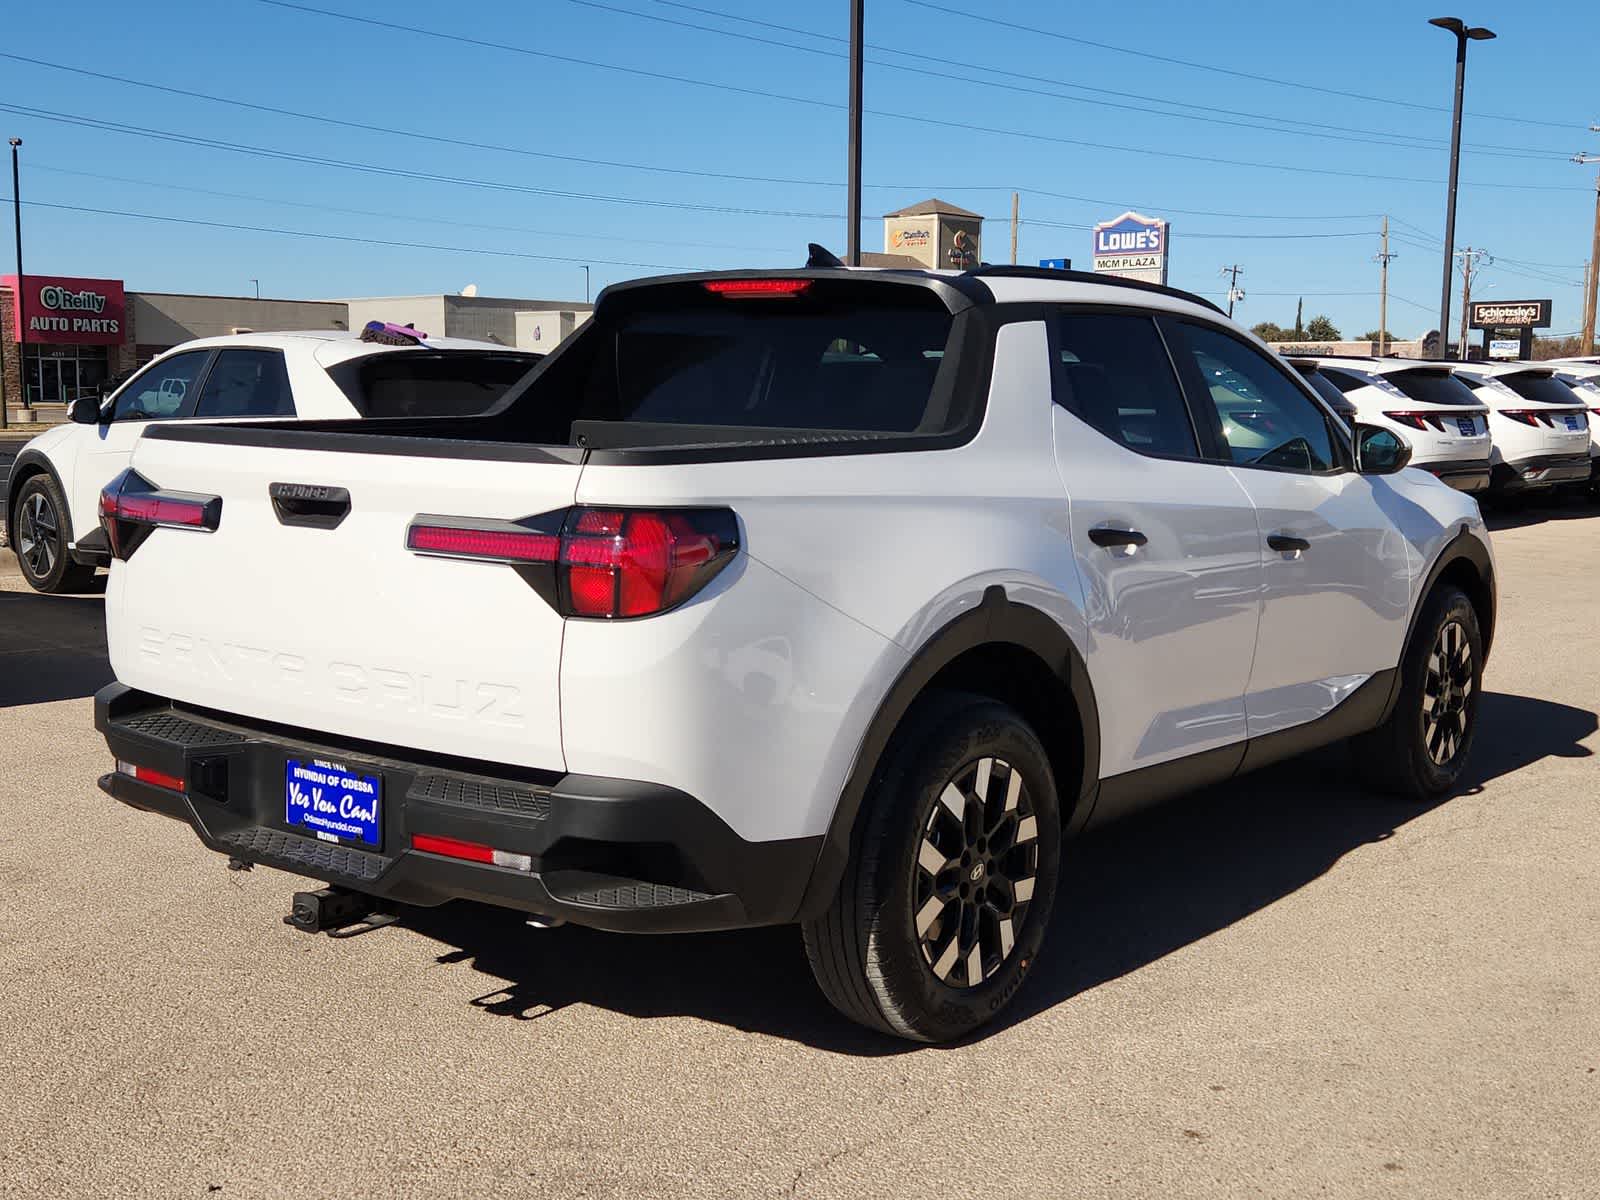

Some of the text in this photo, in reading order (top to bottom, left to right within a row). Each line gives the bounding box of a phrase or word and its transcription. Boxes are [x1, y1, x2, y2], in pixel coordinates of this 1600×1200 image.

[1098, 229, 1159, 251] LOWE'S
[1097, 257, 1156, 269] MCM PLAZA
[40, 286, 106, 313] O'Reilly
[1478, 306, 1536, 318] Schlotzsky's
[30, 316, 119, 333] AUTO PARTS
[327, 660, 526, 729] CRUZ
[293, 767, 374, 794] HYUNDAI OF ODESSA
[289, 782, 378, 824] Yes You Can!
